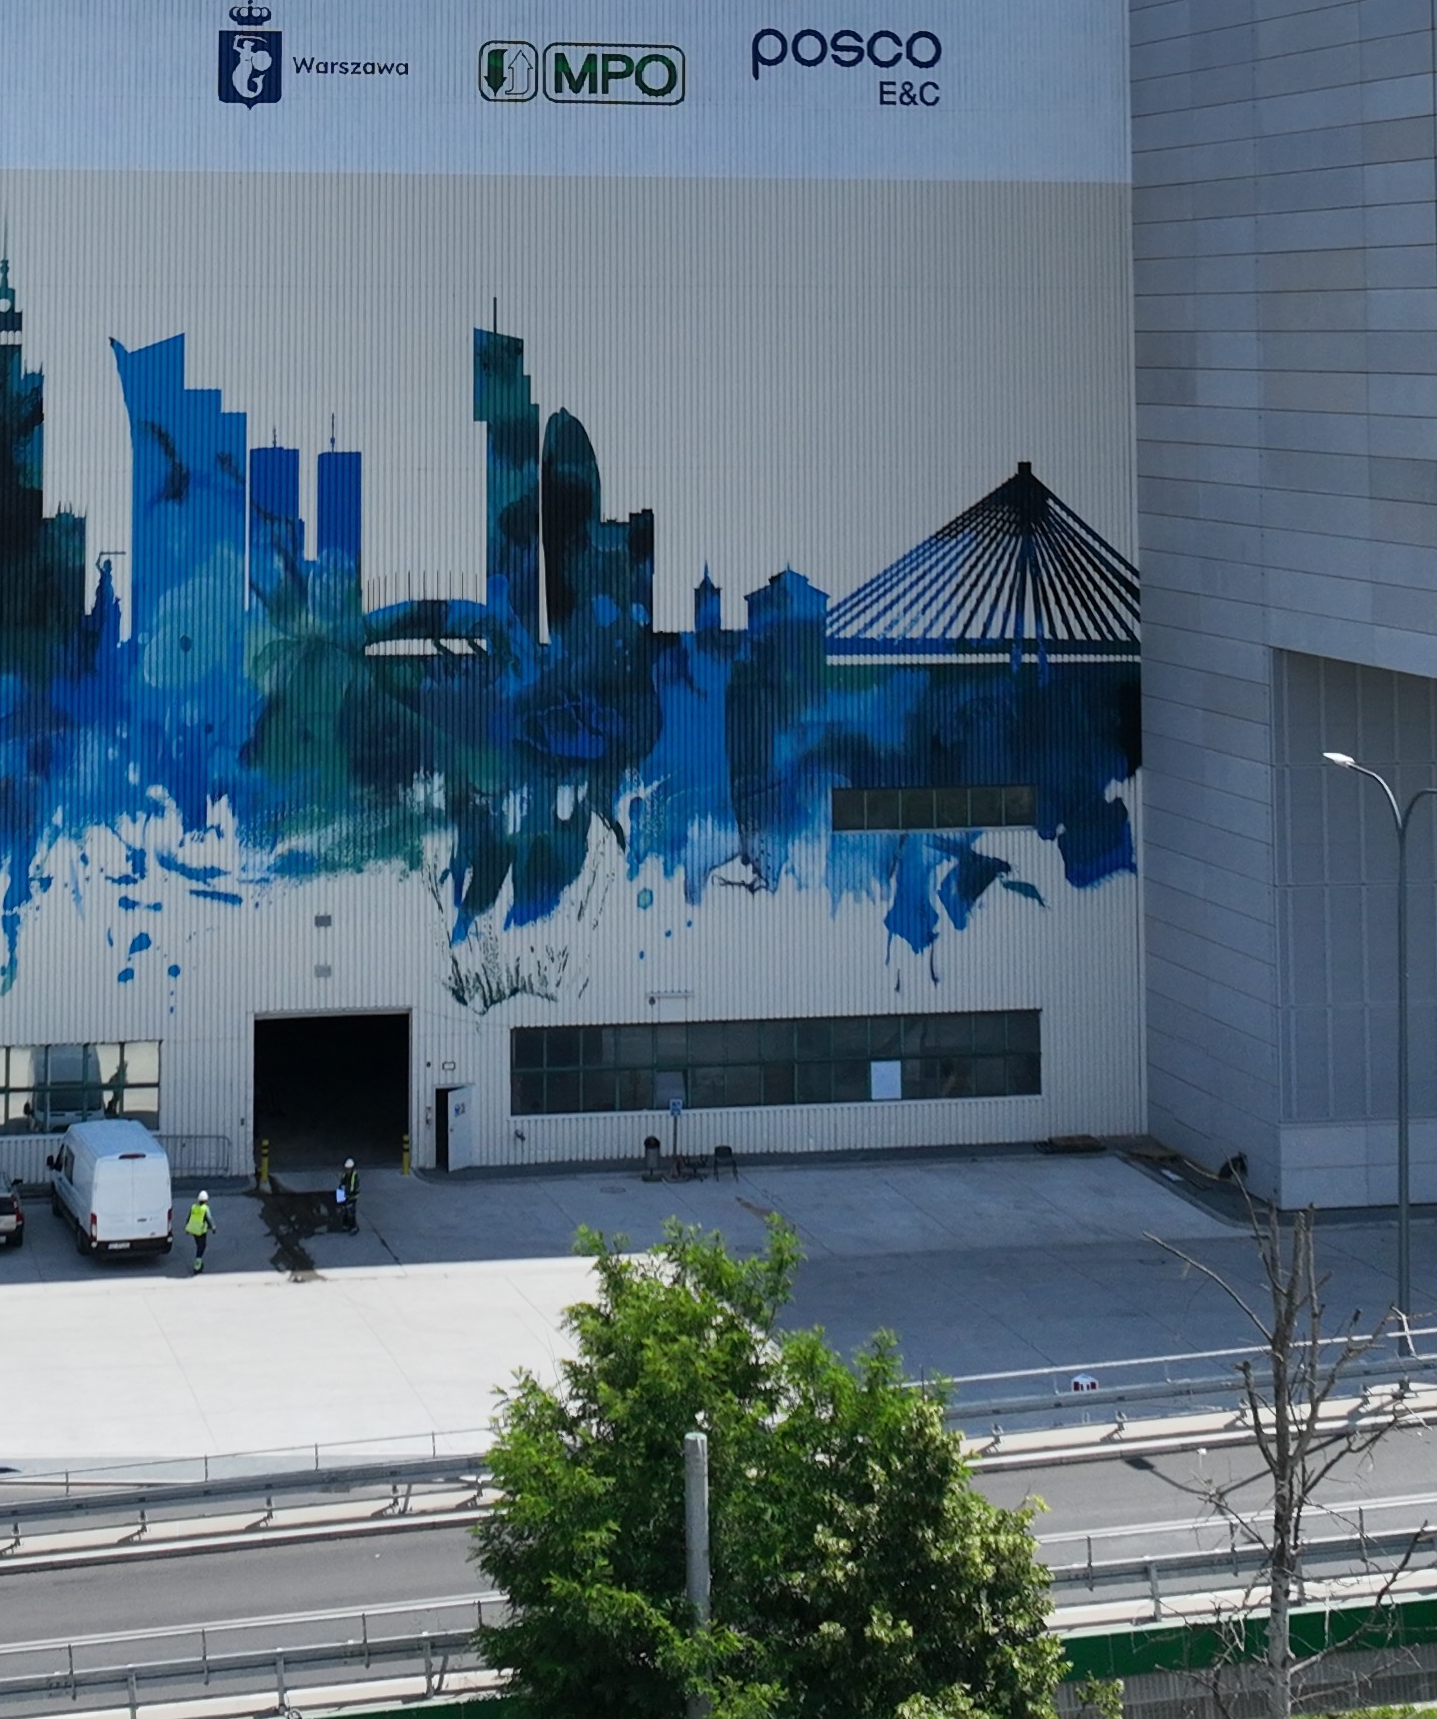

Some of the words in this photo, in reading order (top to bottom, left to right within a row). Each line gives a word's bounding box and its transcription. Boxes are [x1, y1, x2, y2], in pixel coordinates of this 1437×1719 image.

[292, 56, 410, 76] Warszawa
[751, 27, 943, 81] posco
[553, 52, 678, 98] MPO
[879, 80, 941, 107] E&C
